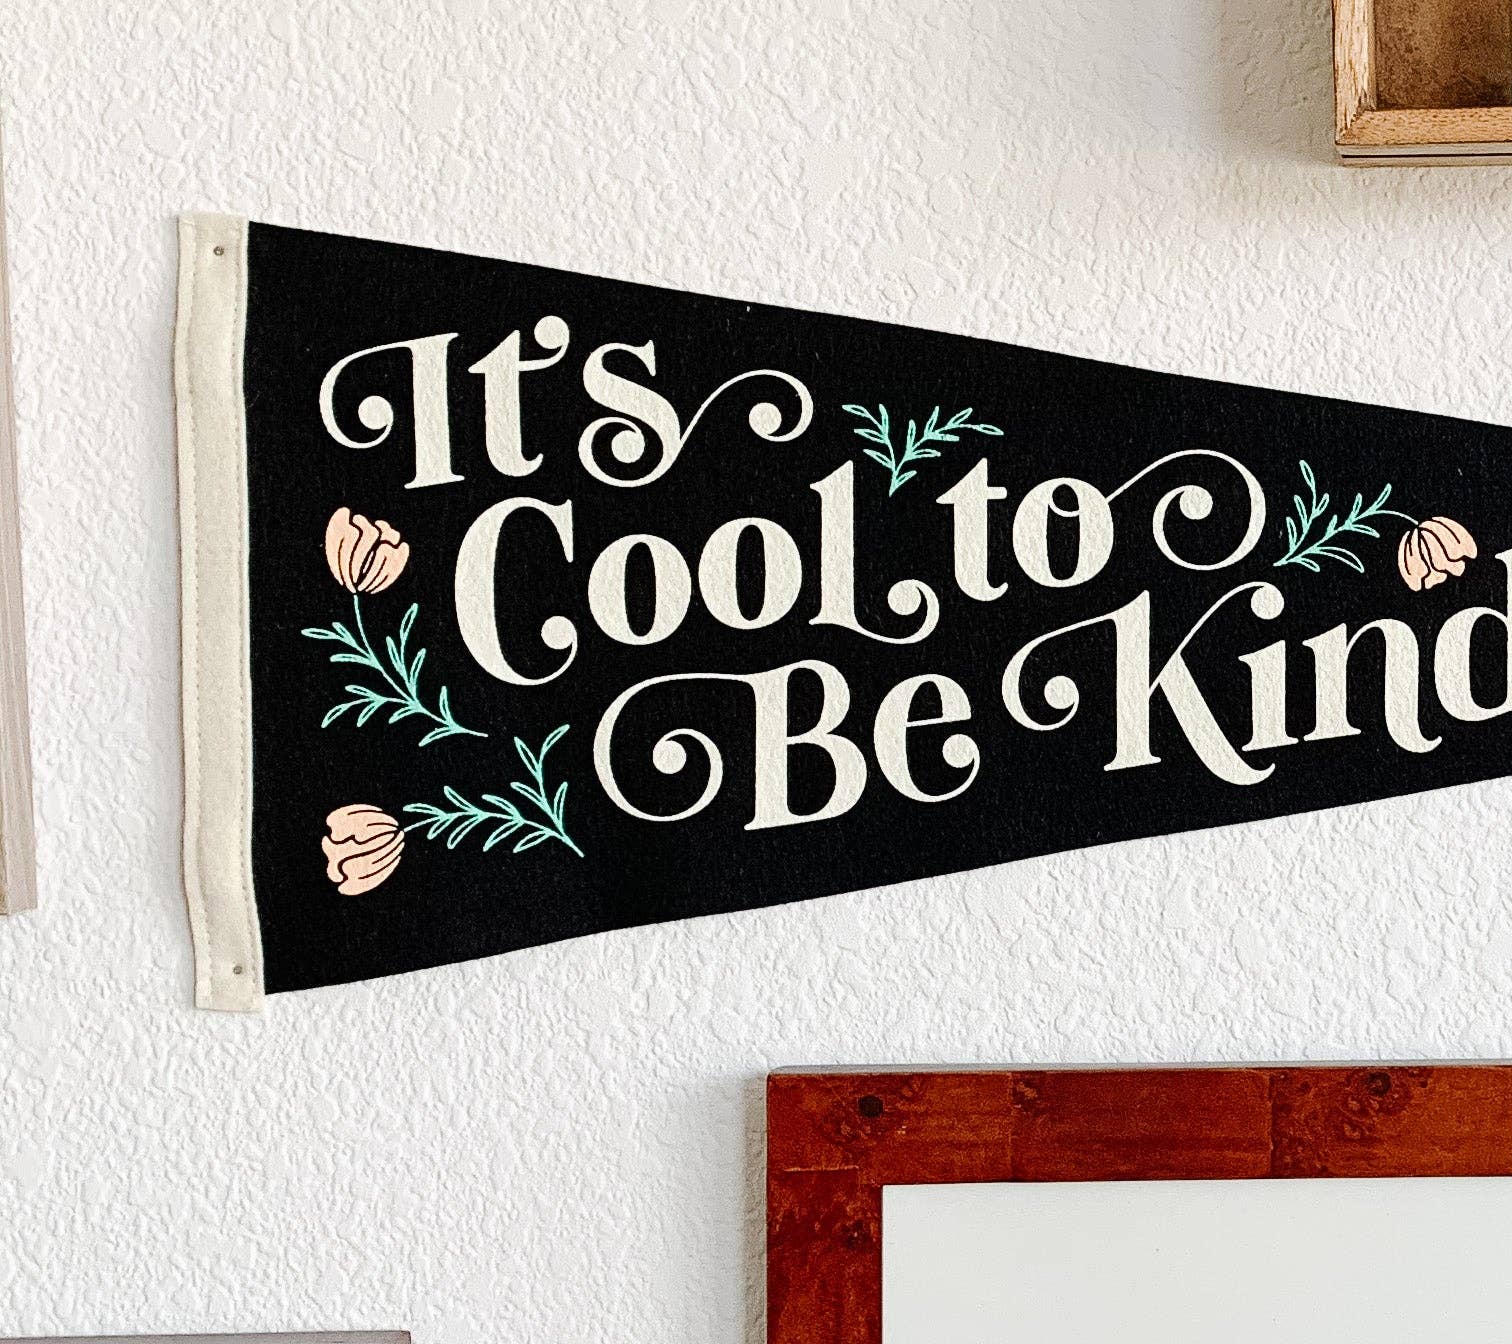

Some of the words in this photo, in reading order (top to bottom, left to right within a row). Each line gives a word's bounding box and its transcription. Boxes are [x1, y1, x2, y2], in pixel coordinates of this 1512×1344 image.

[319, 316, 813, 488] It's
[455, 460, 939, 685] Cool
[936, 449, 1266, 601] to
[593, 660, 980, 830] Be
